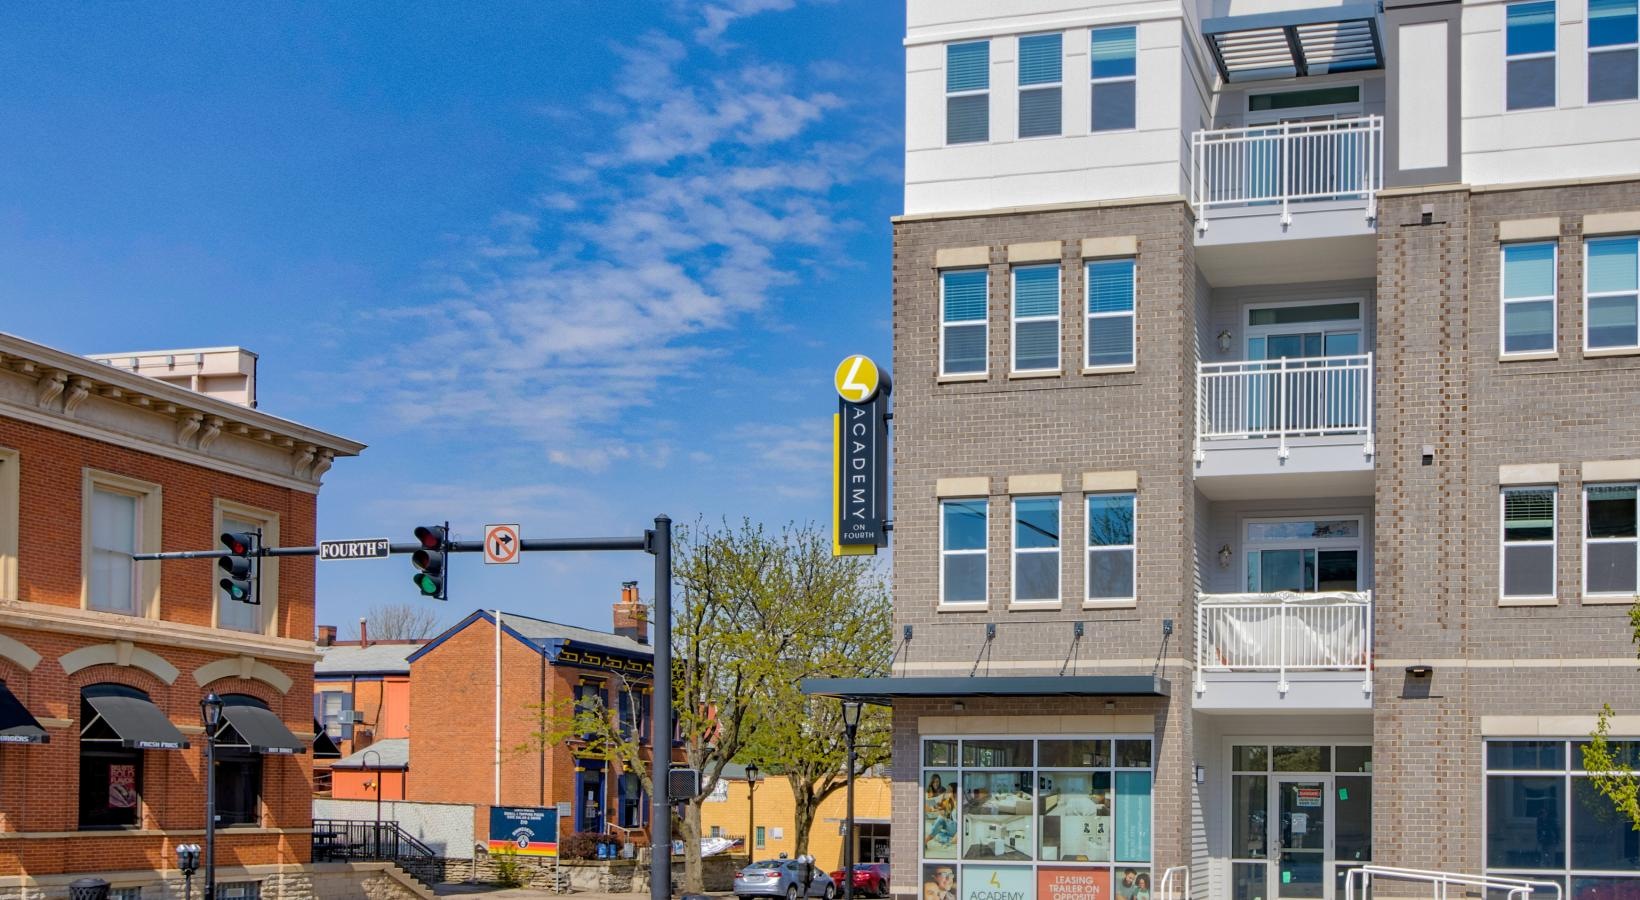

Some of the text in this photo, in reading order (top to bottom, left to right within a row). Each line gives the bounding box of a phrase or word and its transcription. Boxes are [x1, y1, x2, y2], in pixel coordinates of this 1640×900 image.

[852, 407, 866, 520] ACADEMY
[853, 524, 866, 532] ON
[322, 542, 377, 558] FOURTH
[1055, 876, 1094, 884] LEASING
[1048, 884, 1100, 893] TRAILER ON
[970, 891, 1025, 900] ACADEMY
